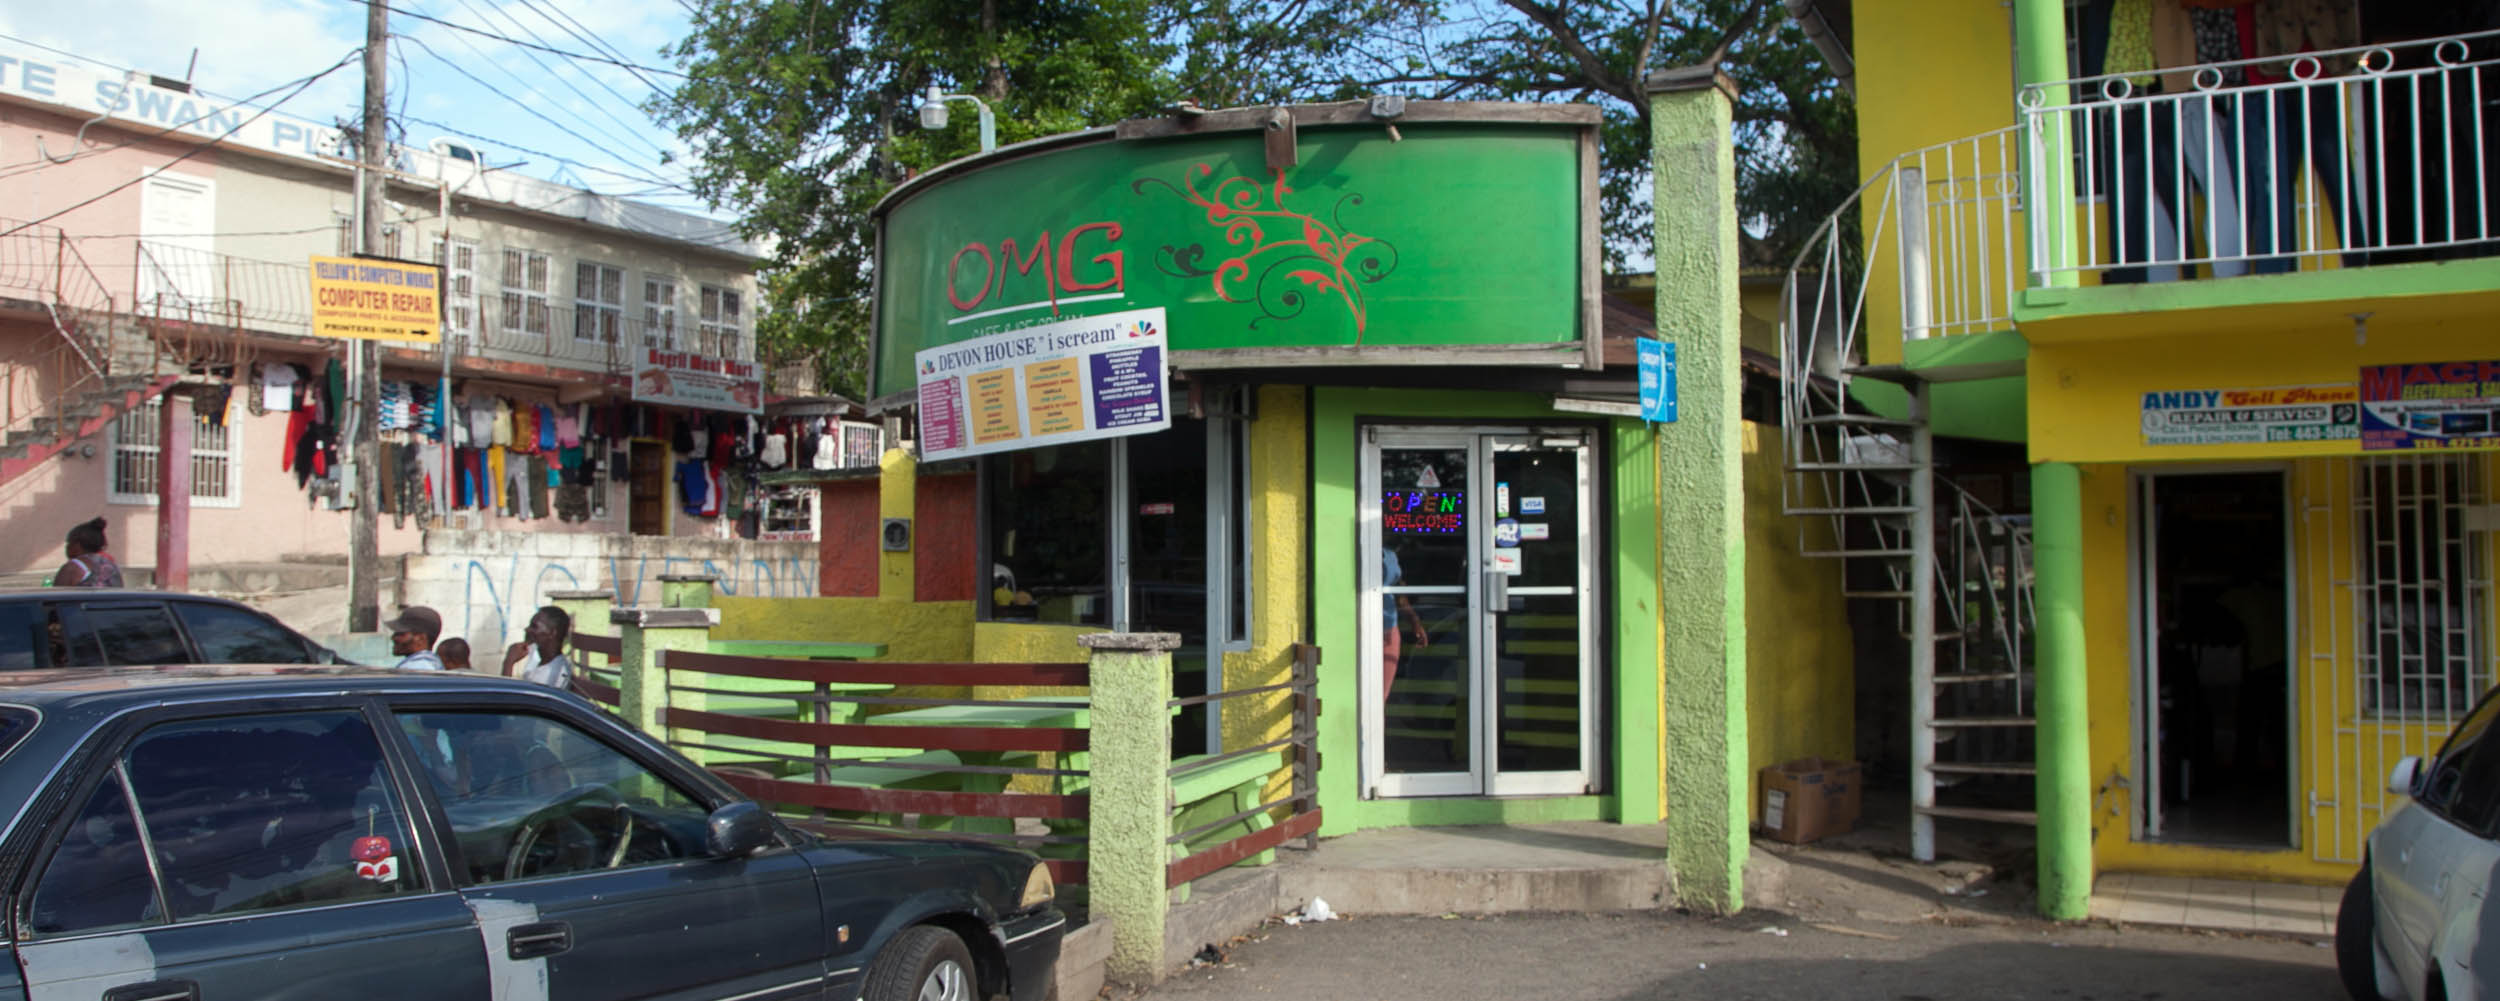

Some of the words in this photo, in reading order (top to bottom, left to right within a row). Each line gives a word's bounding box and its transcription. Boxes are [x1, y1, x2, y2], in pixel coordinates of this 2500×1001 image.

[95, 78, 240, 138] SWAN
[359, 265, 403, 286] COMPUTER
[947, 221, 1124, 316] OMG
[319, 287, 389, 310] COMPUTER
[392, 293, 434, 313] REPAIR
[939, 347, 983, 373] DEVON
[983, 336, 1038, 363] HOUSE
[2144, 391, 2220, 409] ANDY
[2171, 410, 2231, 424] REPAIR
[2253, 407, 2323, 422] SERVICE
[1388, 495, 1457, 512] OPEN
[1384, 514, 1458, 528] WELCOME
